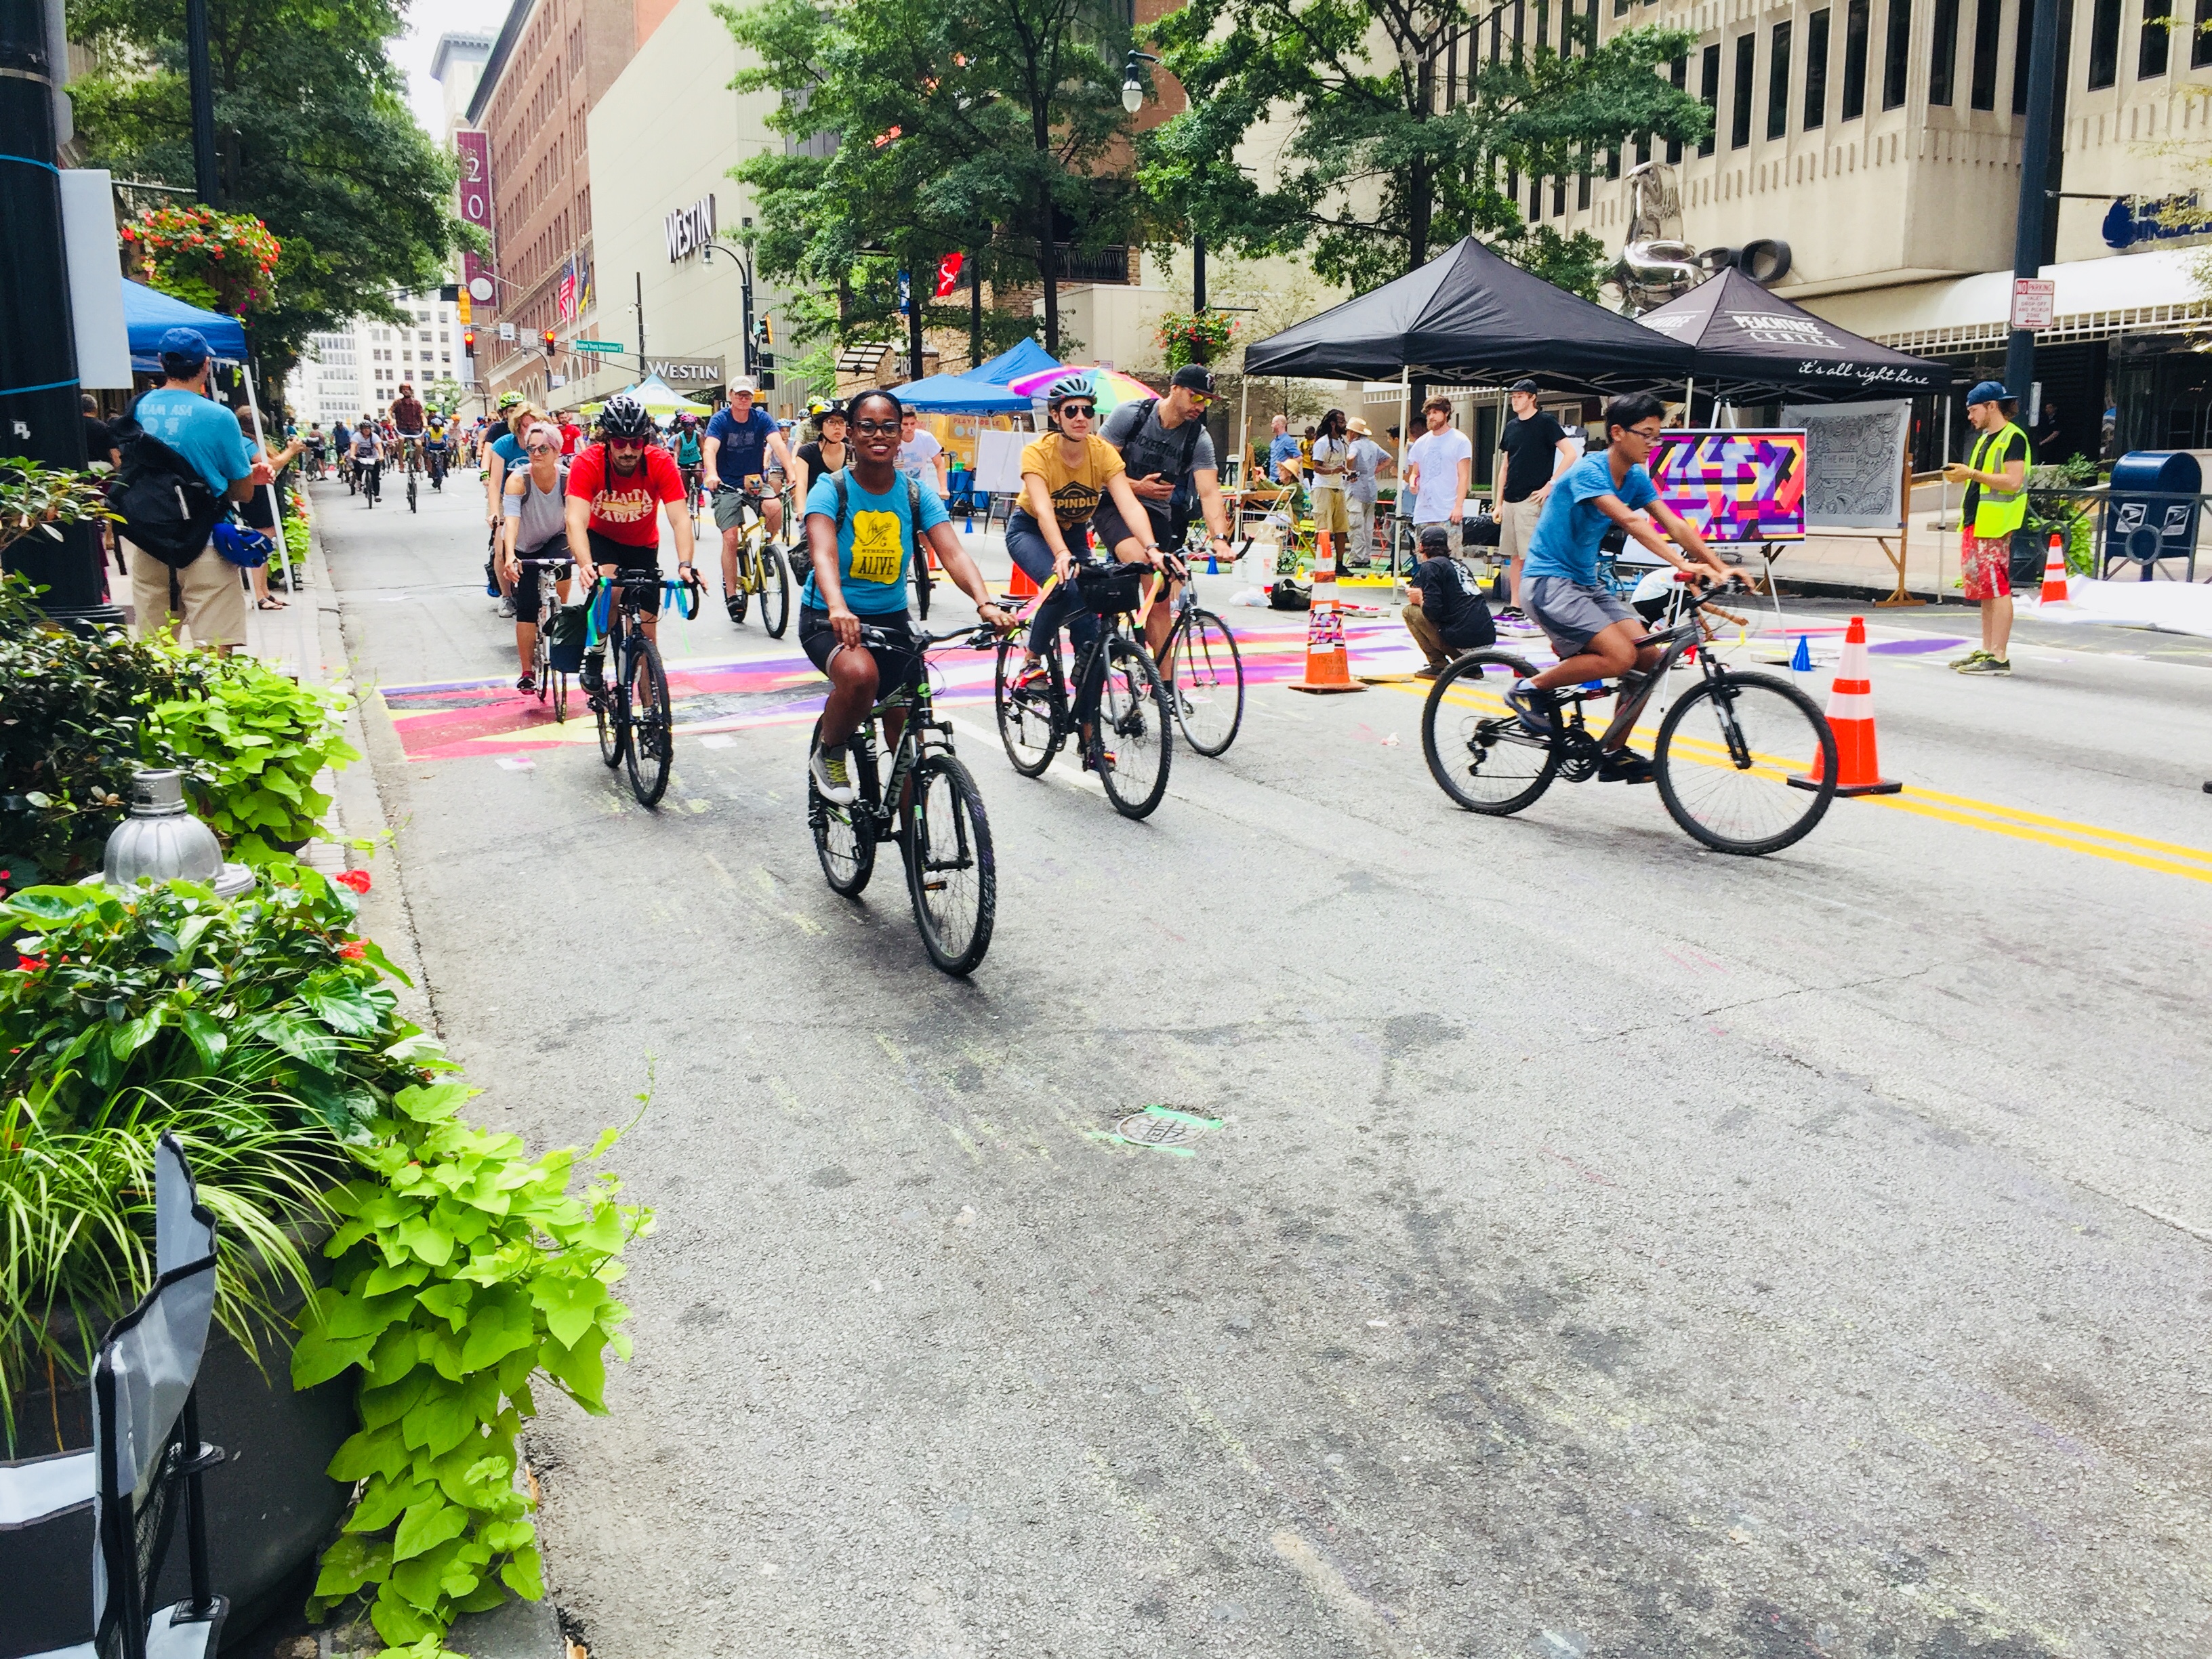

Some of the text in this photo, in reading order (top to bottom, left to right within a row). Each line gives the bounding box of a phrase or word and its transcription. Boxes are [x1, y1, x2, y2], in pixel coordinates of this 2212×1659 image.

[663, 194, 714, 263] WESTIN
[2018, 282, 2052, 293] NO PARKING
[1732, 315, 1824, 335] PEACHTREE
[1750, 332, 1839, 346] CENTER
[647, 361, 718, 380] WESTIN
[1799, 360, 1930, 386] it's all right here
[138, 404, 192, 417] TEAM ASA
[1823, 455, 1854, 464] THE HUB
[590, 503, 653, 523] HAWKS
[858, 556, 895, 575] ALIVE
[886, 743, 912, 806] GIANT
